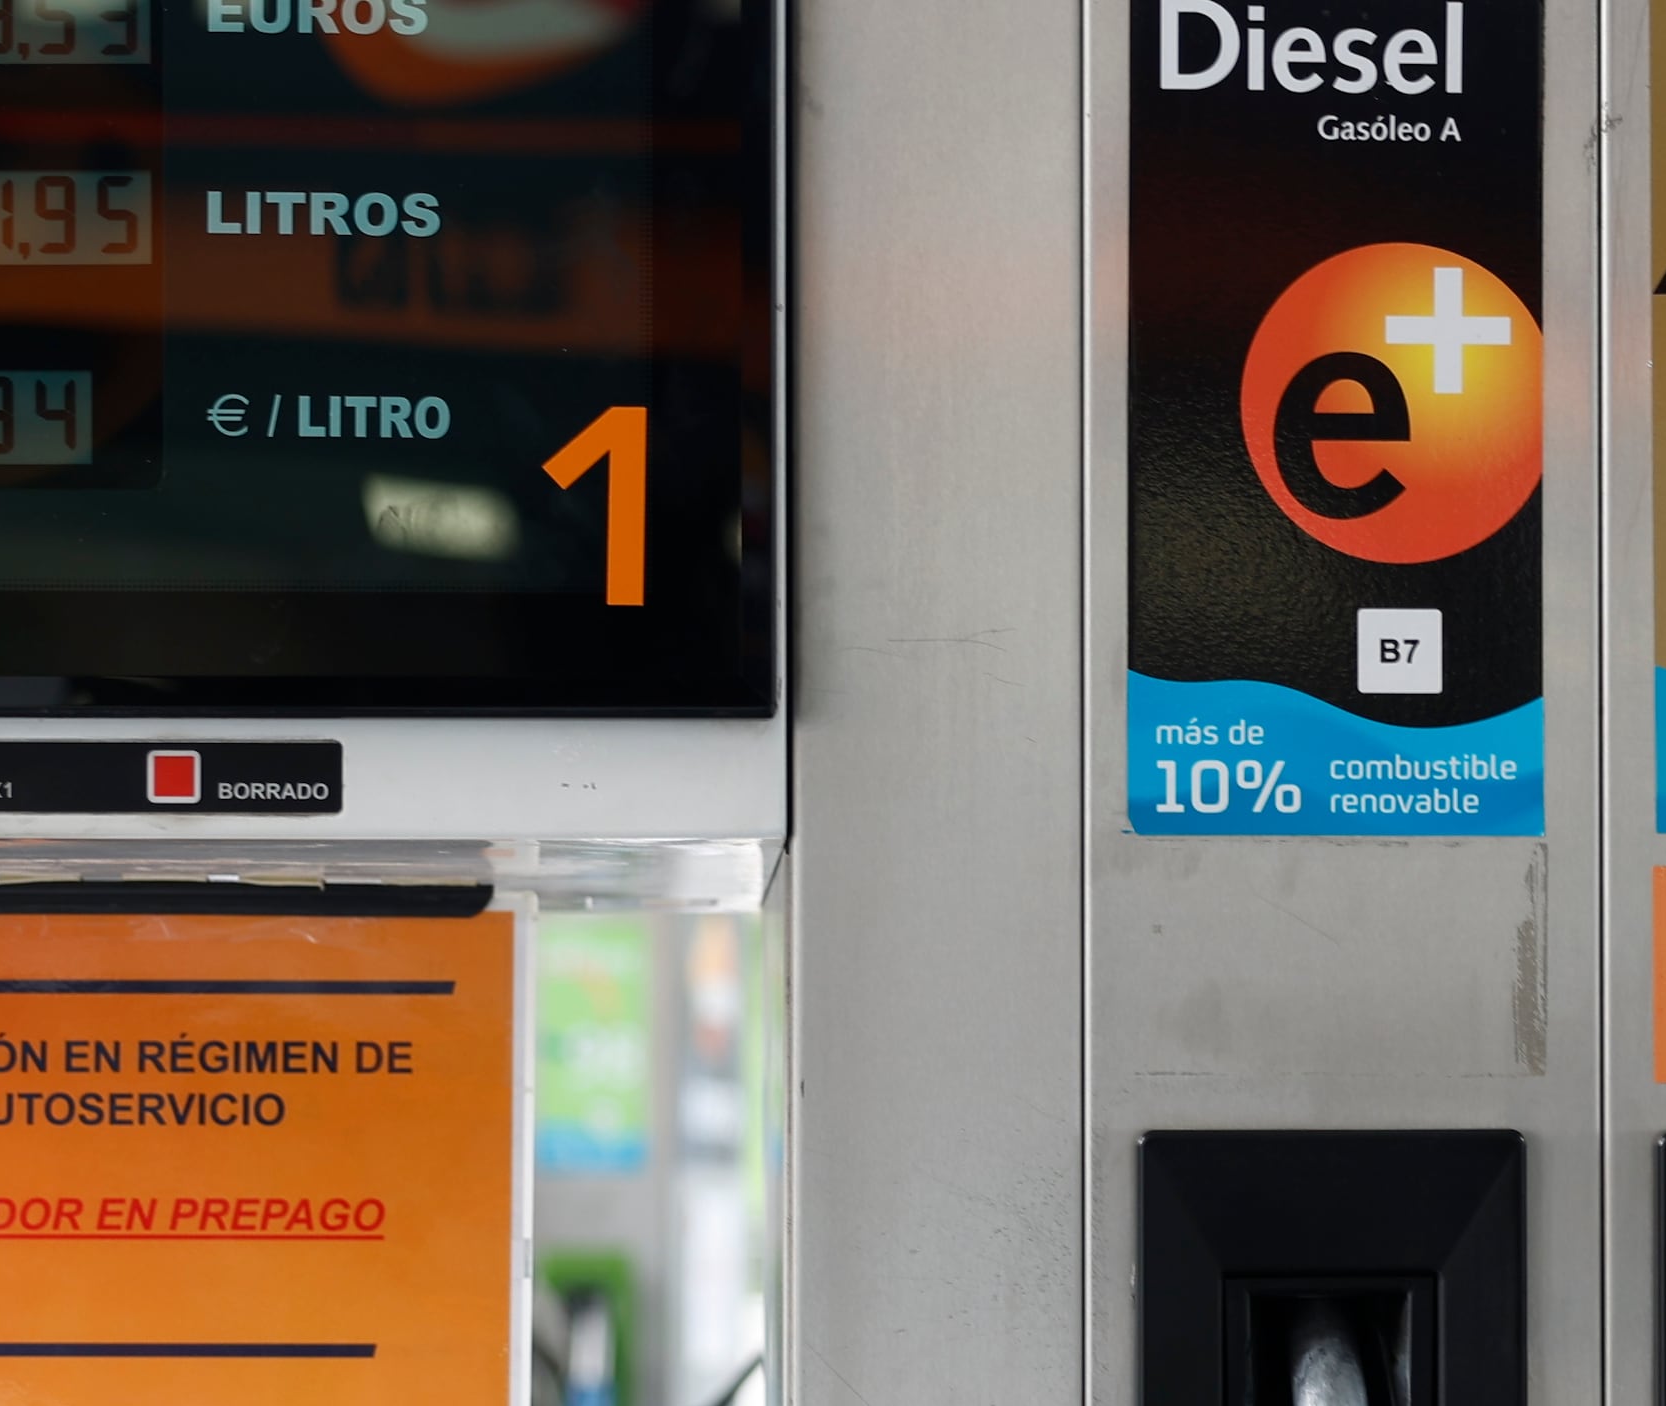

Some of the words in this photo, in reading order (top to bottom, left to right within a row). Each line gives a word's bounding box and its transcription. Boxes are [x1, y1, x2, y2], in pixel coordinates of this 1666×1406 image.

[206, 0, 430, 36] EUROS
[1159, 0, 1464, 95] Diesel
[1316, 114, 1432, 142] Gasóleo
[1439, 116, 1462, 142] A
[206, 190, 442, 238] LITROS
[206, 393, 250, 438] €
[298, 395, 451, 439] LITRO
[541, 405, 648, 606] 1
[1380, 638, 1420, 664] B7
[1155, 716, 1219, 746] más
[1228, 718, 1265, 746] de
[1330, 753, 1518, 780] combustible
[218, 782, 329, 800] BORRADO
[1156, 759, 1302, 814] 10%
[1330, 787, 1479, 814] renovable
[64, 1039, 121, 1073] EN
[137, 1032, 339, 1074] RÉGIMEN
[355, 1040, 414, 1075] DE
[96, 1197, 158, 1231] EN
[169, 1197, 386, 1232] PREPAGO
